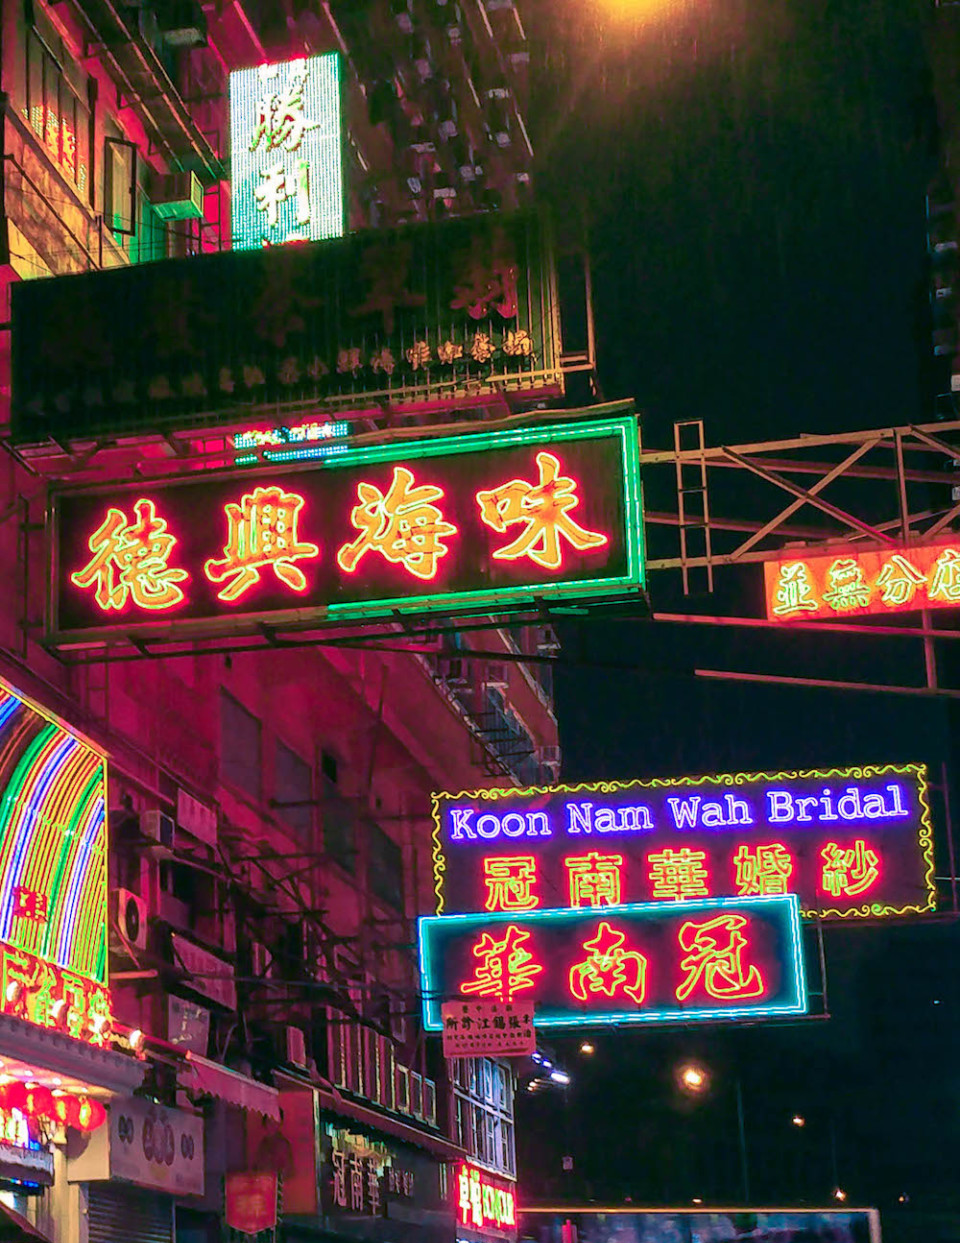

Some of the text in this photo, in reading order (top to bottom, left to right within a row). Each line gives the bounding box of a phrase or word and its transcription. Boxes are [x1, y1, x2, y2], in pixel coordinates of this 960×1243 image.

[249, 58, 320, 244] 勝利
[70, 452, 607, 611] 德興海味
[773, 549, 960, 615] 並無分店
[450, 785, 908, 840] Koon Nam Wah Bridal
[483, 840, 879, 912] 冠南華婚紗
